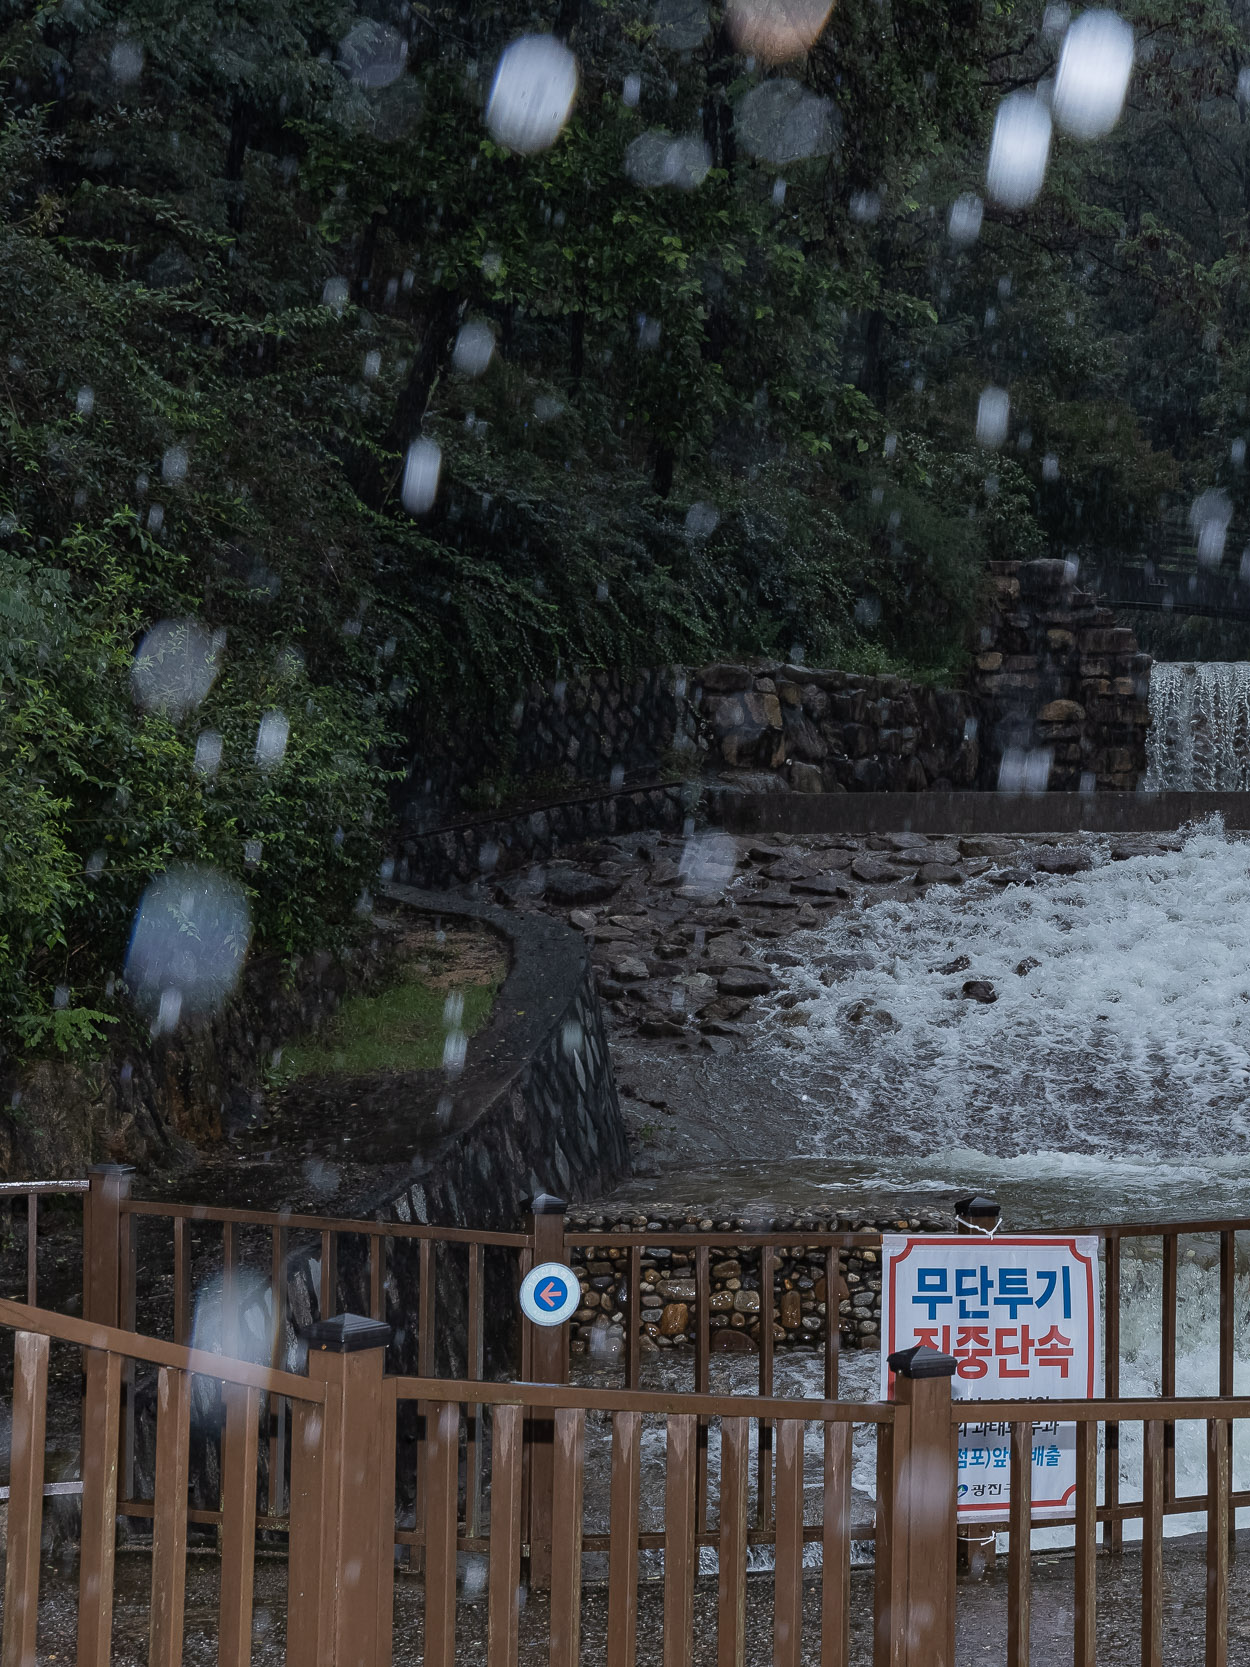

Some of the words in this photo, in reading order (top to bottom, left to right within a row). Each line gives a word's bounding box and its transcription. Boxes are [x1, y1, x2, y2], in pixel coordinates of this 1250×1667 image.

[912, 1266, 1071, 1319] 무단투기
[971, 1421, 1012, 1437] 과태
[957, 1446, 1011, 1469] 점포)앞
